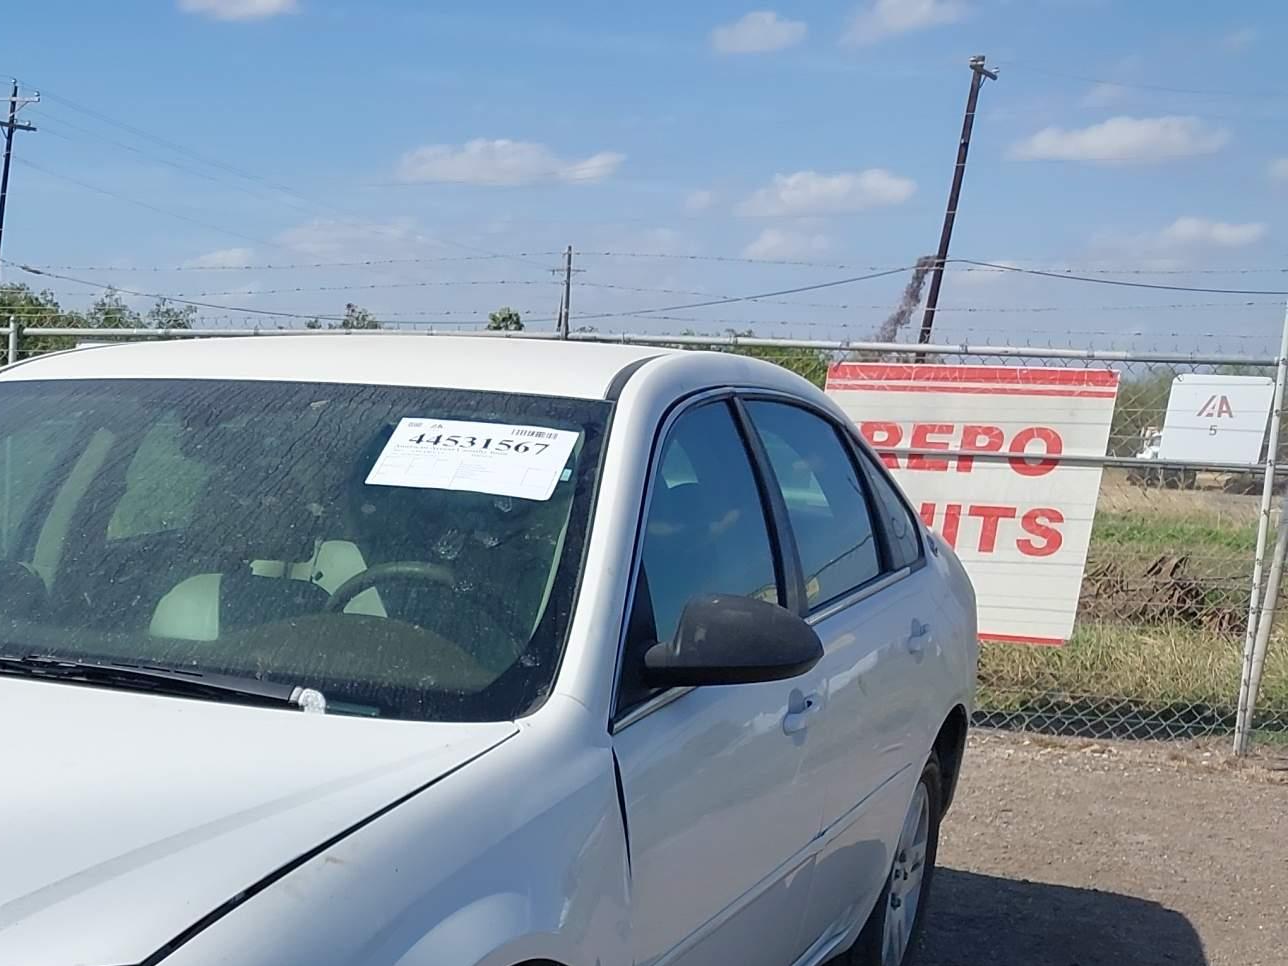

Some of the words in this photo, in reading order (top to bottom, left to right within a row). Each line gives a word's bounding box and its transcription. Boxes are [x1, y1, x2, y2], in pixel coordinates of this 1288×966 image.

[1208, 425, 1218, 436] 5
[408, 432, 550, 456] 44531567
[860, 421, 1063, 477] REPO
